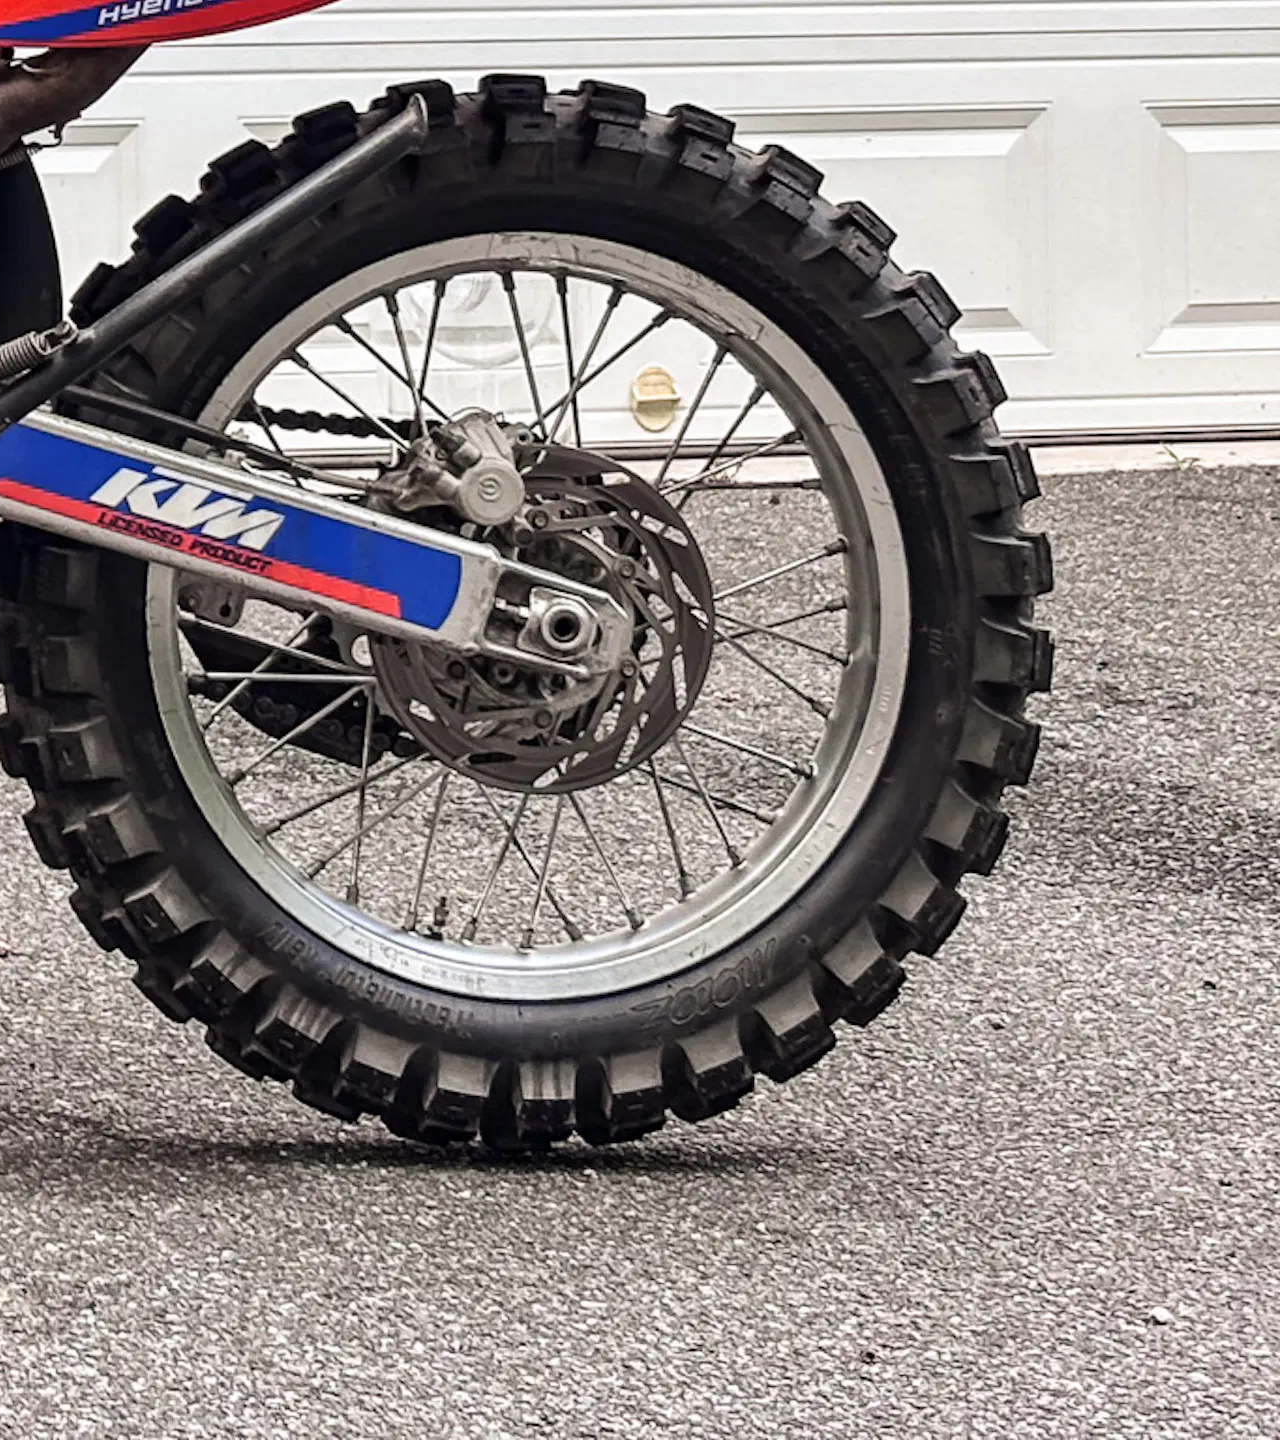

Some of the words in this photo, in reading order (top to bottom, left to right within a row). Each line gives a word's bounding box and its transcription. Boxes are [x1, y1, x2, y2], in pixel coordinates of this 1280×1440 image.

[89, 466, 286, 551] KTM
[96, 510, 182, 548] LICENSED
[188, 540, 273, 575] PRODUCT
